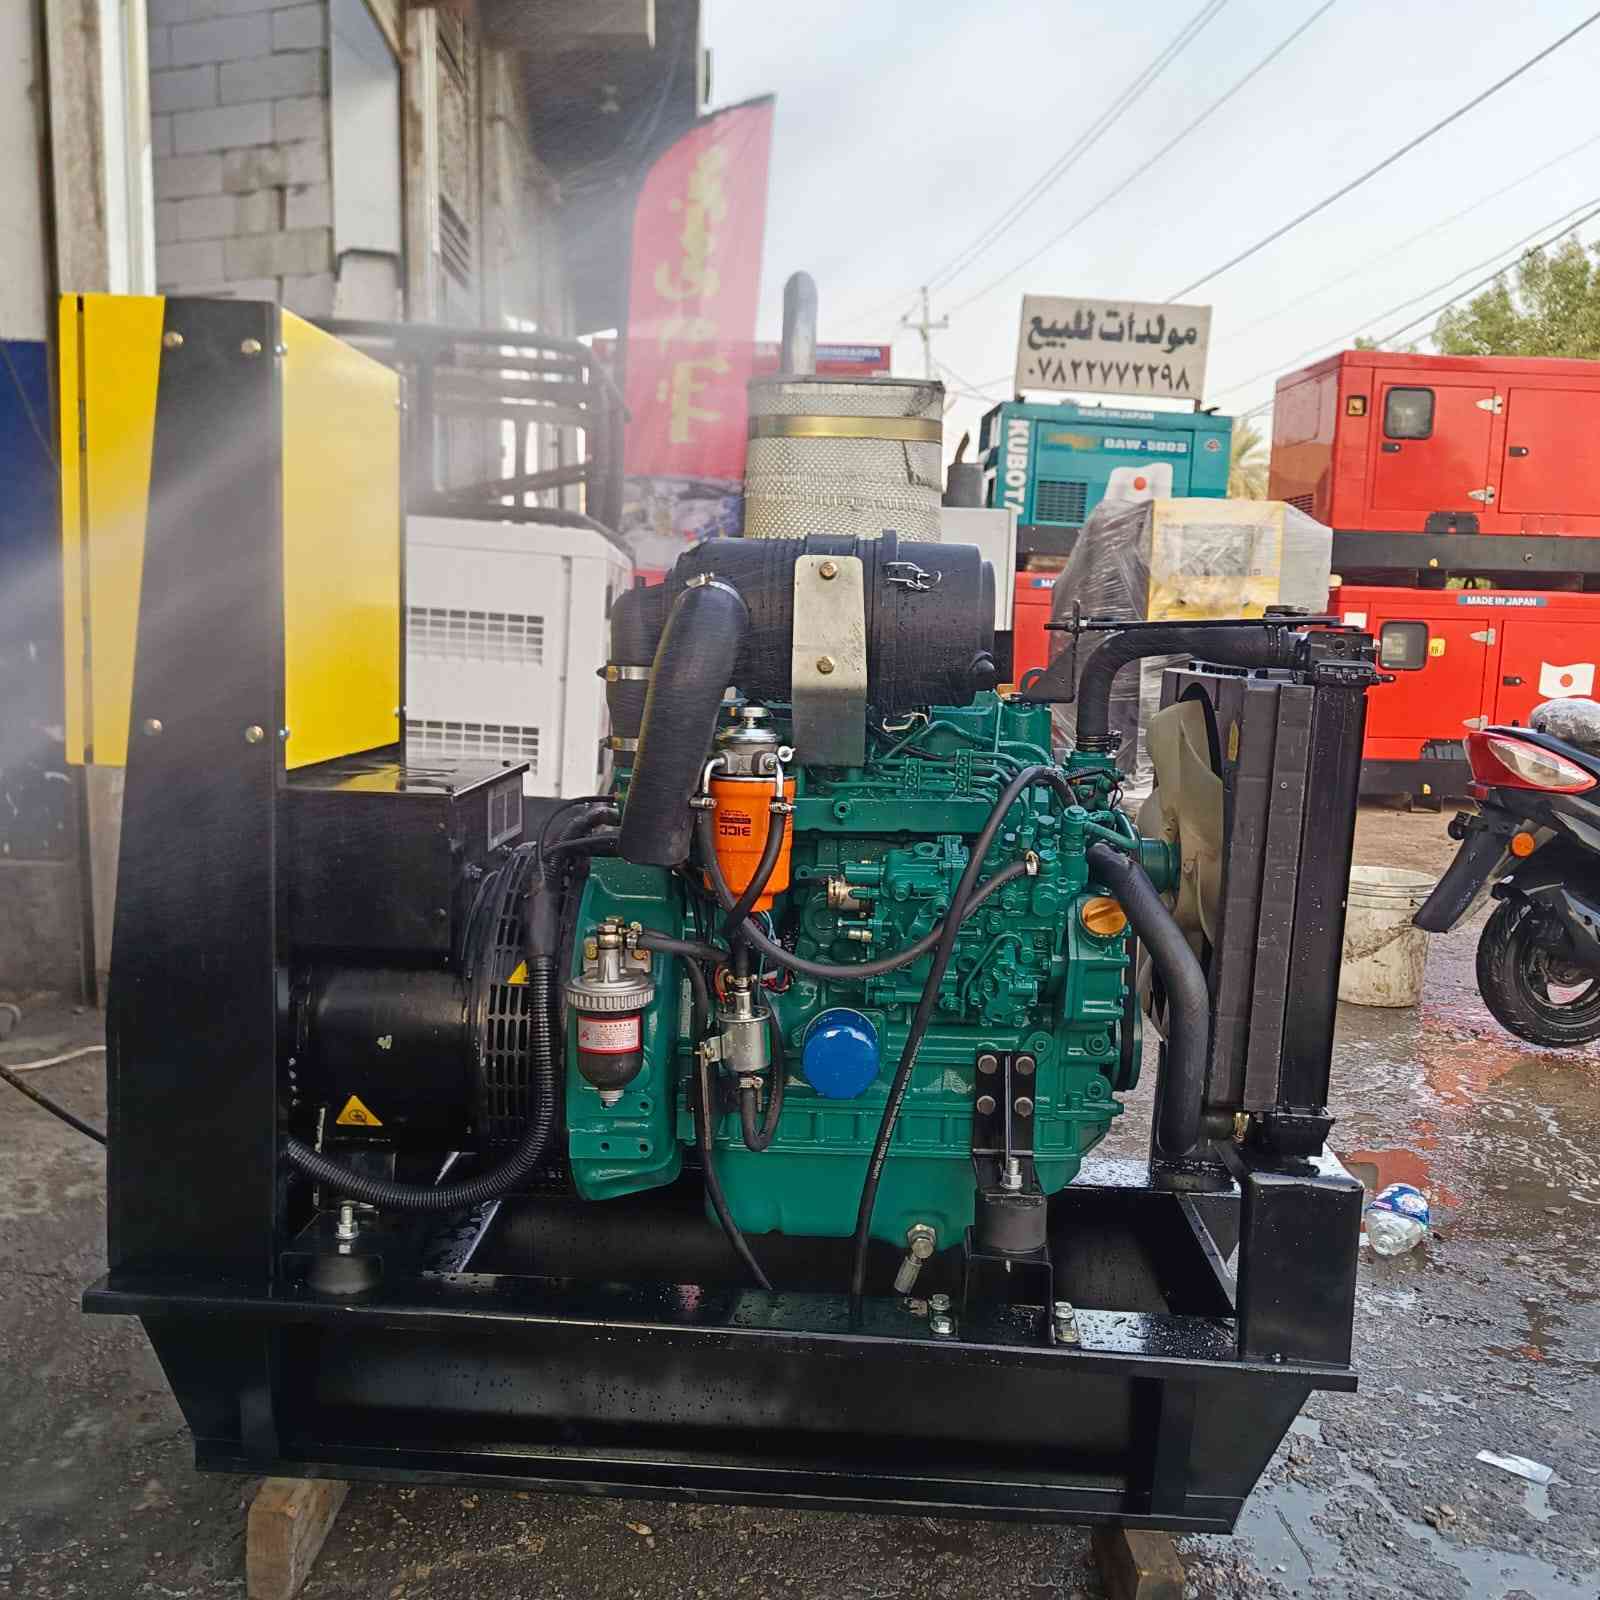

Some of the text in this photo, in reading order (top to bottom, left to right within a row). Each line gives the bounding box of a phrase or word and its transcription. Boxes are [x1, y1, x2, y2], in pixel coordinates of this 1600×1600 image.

[1027, 309, 1198, 353] مولدات للبيع
[1004, 418, 1029, 514] KUBOTA
[1466, 595, 1537, 607] MADE IN JAPAN
